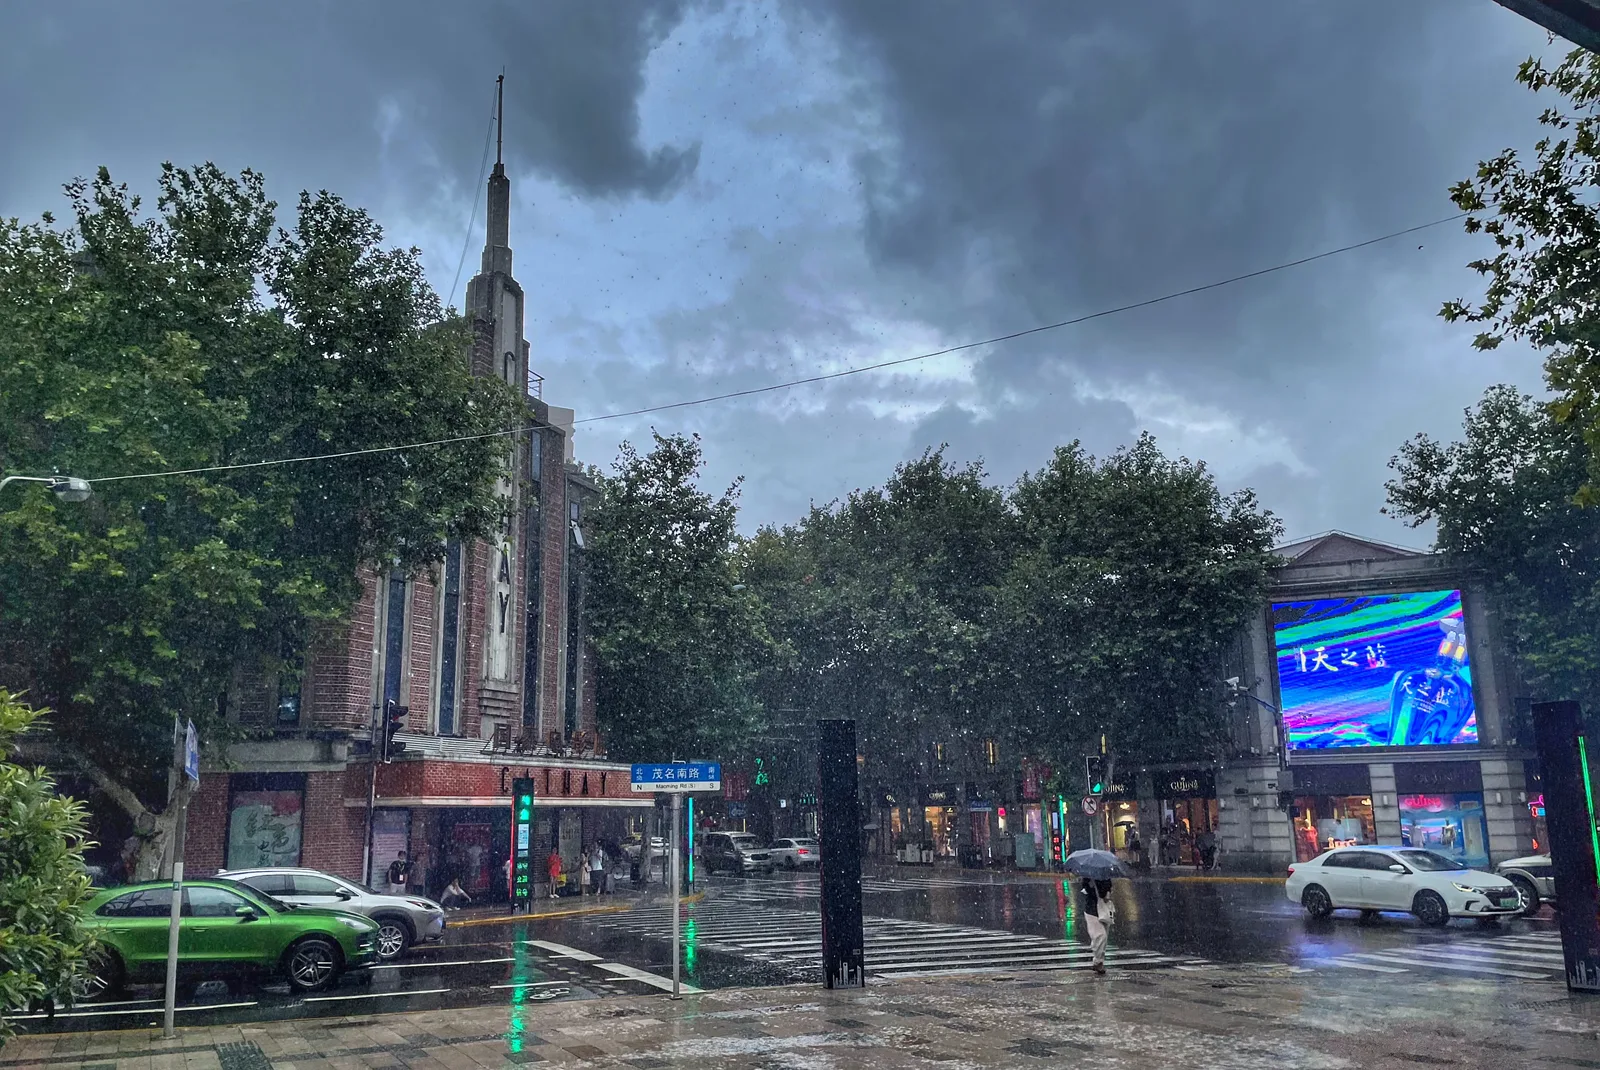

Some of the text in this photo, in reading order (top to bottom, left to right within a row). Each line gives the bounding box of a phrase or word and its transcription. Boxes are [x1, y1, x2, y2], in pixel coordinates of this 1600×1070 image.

[636, 767, 643, 775] 北
[652, 767, 700, 780] 茂名南路
[708, 766, 715, 774] 南
